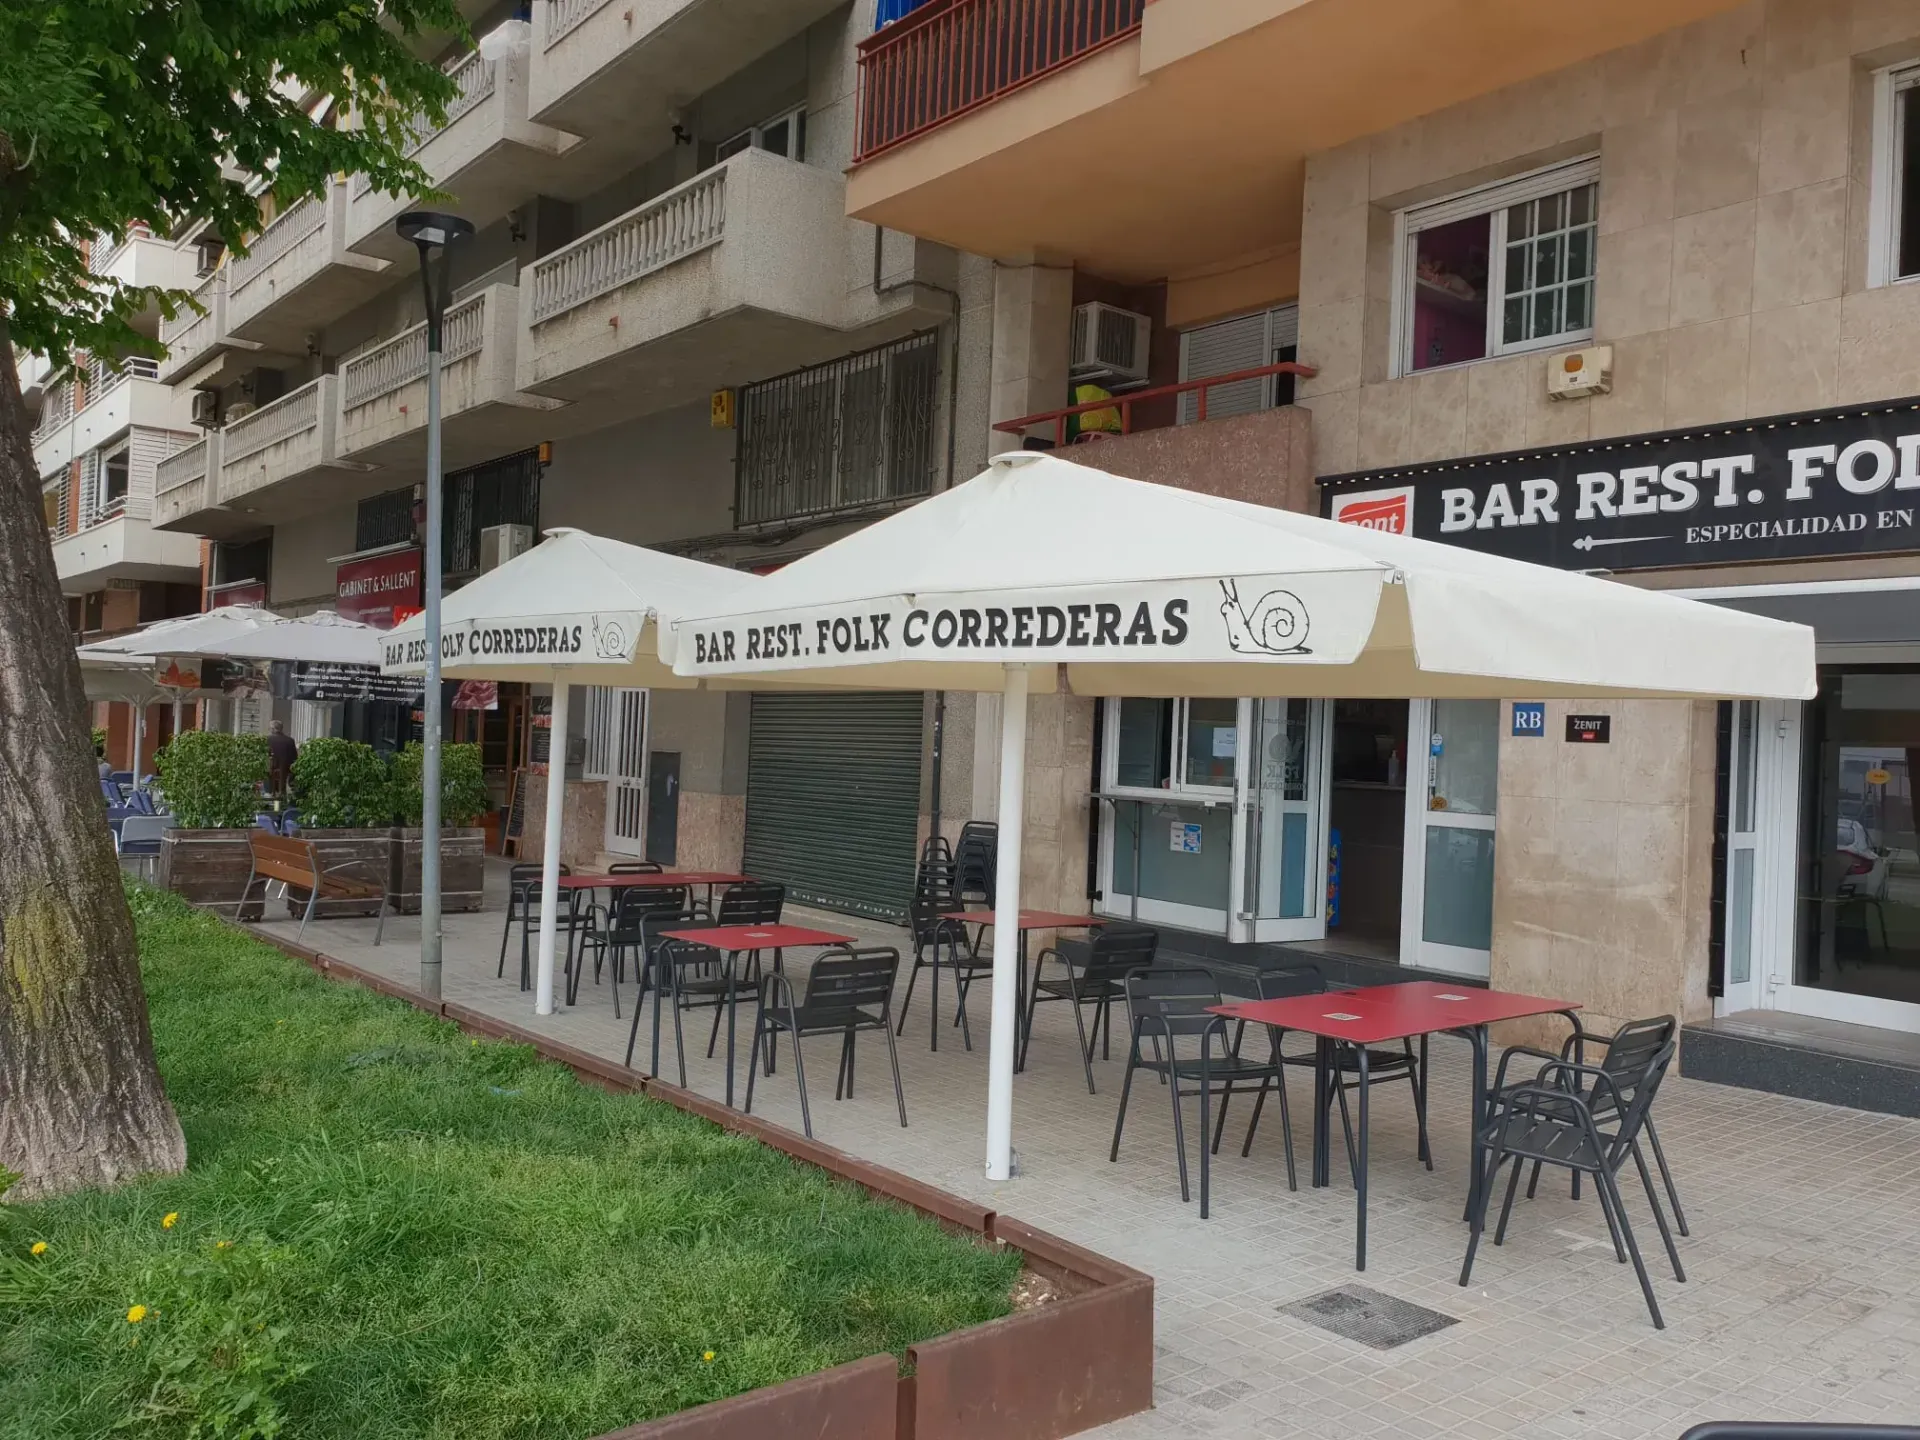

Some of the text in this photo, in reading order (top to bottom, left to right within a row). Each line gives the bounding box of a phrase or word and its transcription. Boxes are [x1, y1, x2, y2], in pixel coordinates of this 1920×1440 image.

[1440, 434, 1920, 533] BAR REST. FOL
[1685, 508, 1914, 544] ESPECIALIDAD EN
[339, 577, 372, 598] GABINET
[380, 570, 416, 592] SALLENT
[385, 625, 582, 666] BAR RES OLK CORREDERAS
[695, 599, 1189, 664] BAR REST. FOLK CORREDERAS
[1515, 711, 1541, 729] RB
